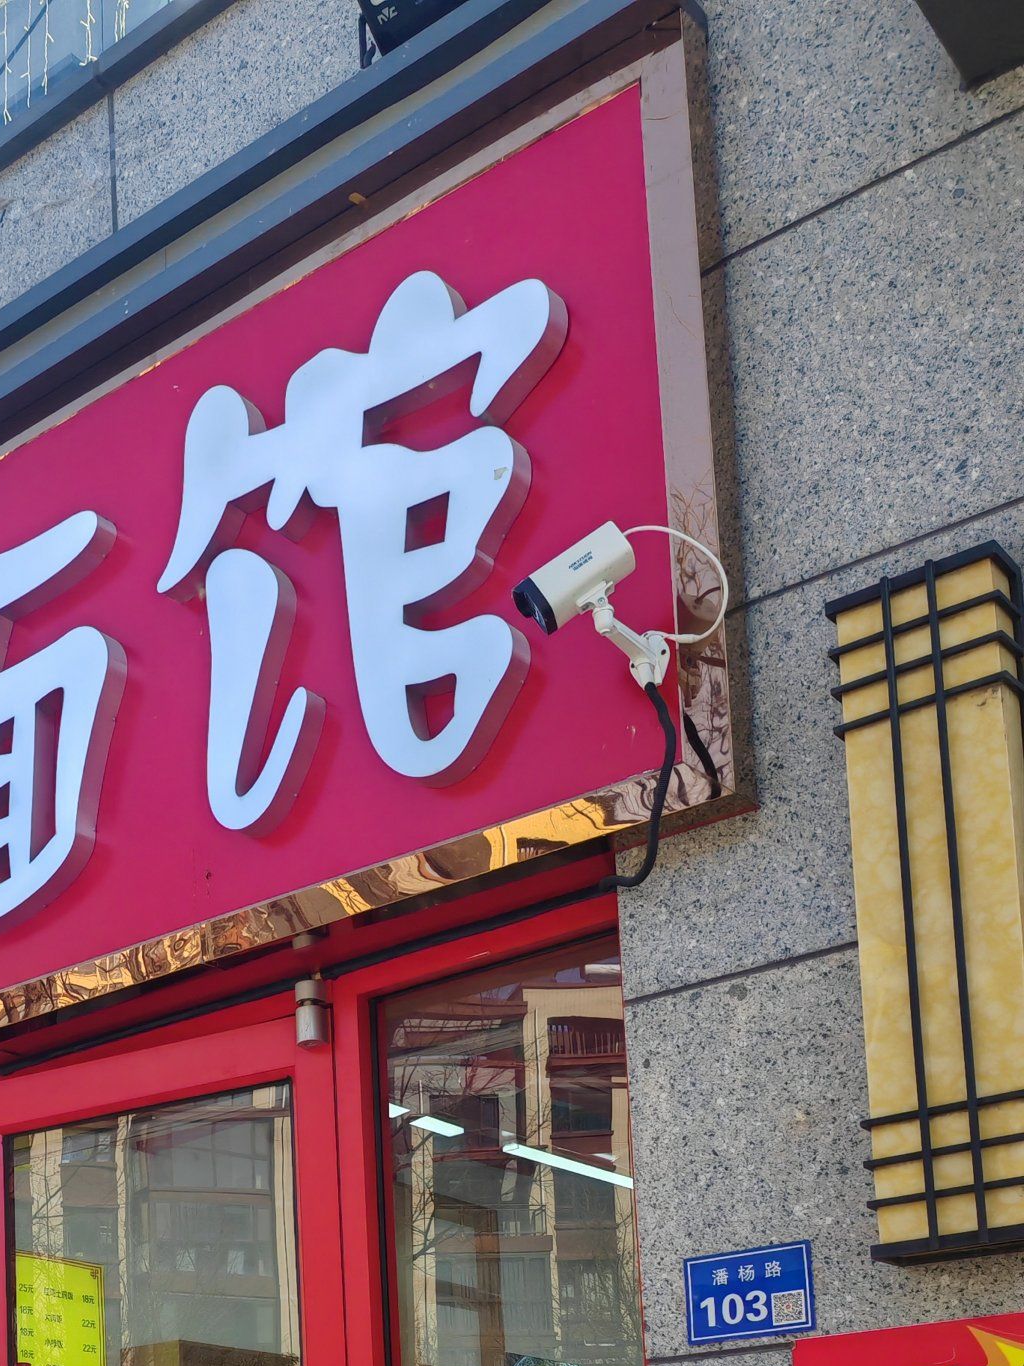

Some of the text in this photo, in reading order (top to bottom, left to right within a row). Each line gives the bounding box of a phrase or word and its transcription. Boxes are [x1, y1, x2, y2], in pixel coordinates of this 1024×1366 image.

[711, 1260, 782, 1286] 潘杨路
[18, 1282, 34, 1294] 25元
[82, 1294, 95, 1305] 18元
[699, 1290, 769, 1328] 103
[81, 1319, 96, 1329] 22元
[82, 1344, 97, 1354] 22元
